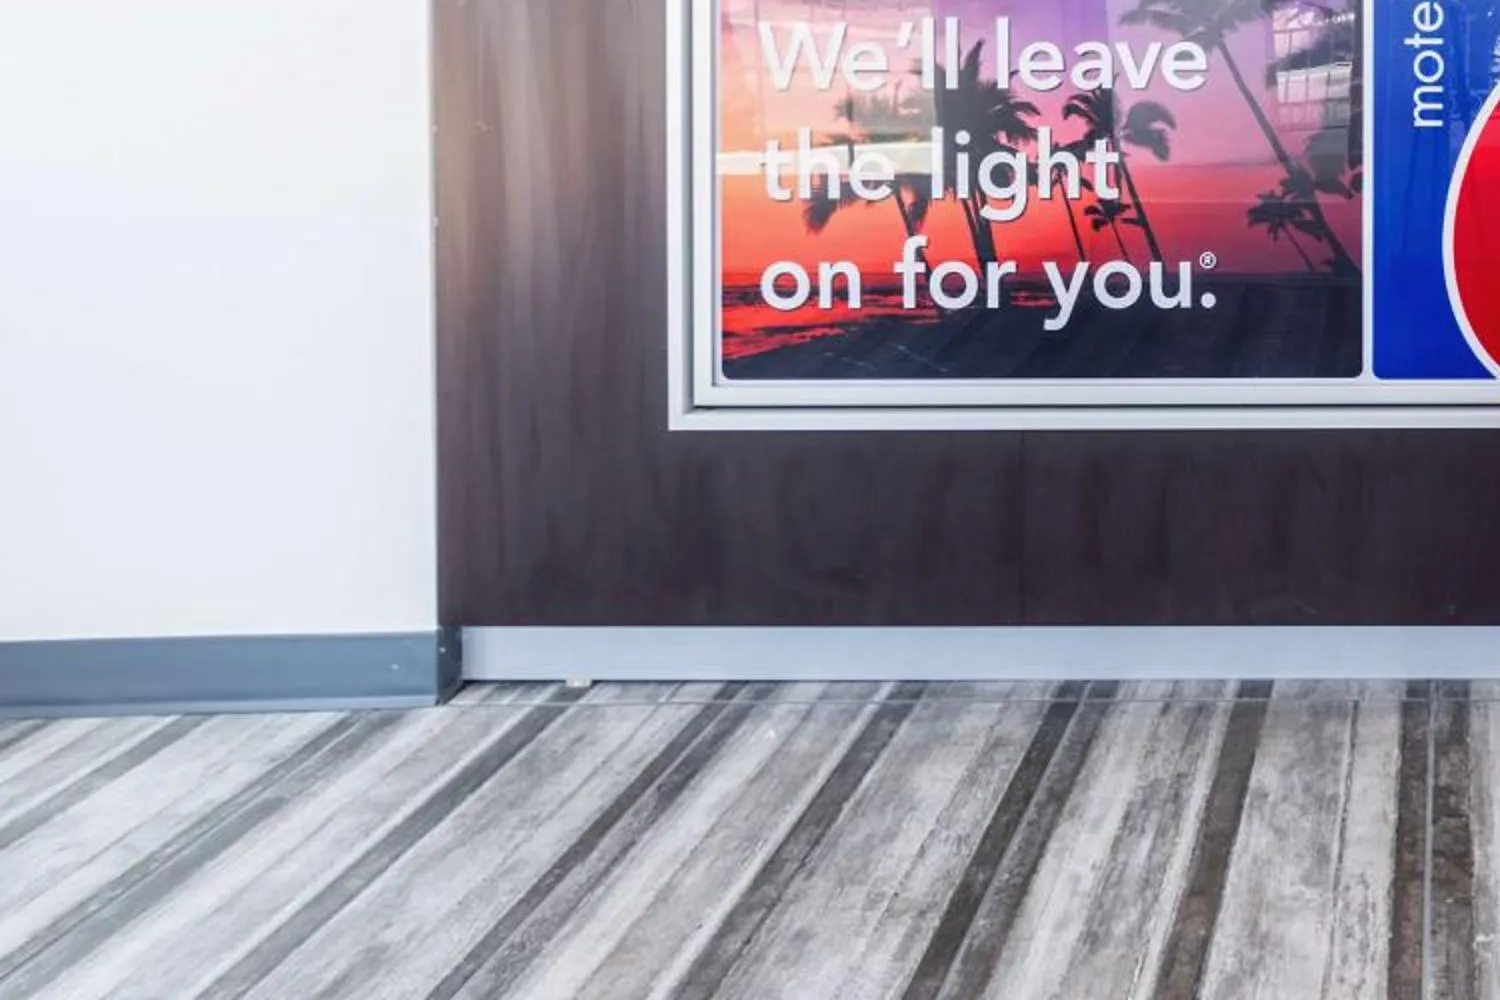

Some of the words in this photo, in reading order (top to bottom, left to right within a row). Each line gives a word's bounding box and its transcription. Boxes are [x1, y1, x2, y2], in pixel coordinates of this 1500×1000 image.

[996, 16, 1209, 91] leave
[761, 126, 895, 202] the
[930, 126, 1120, 223] light
[760, 258, 861, 311] on
[894, 235, 1017, 311] for
